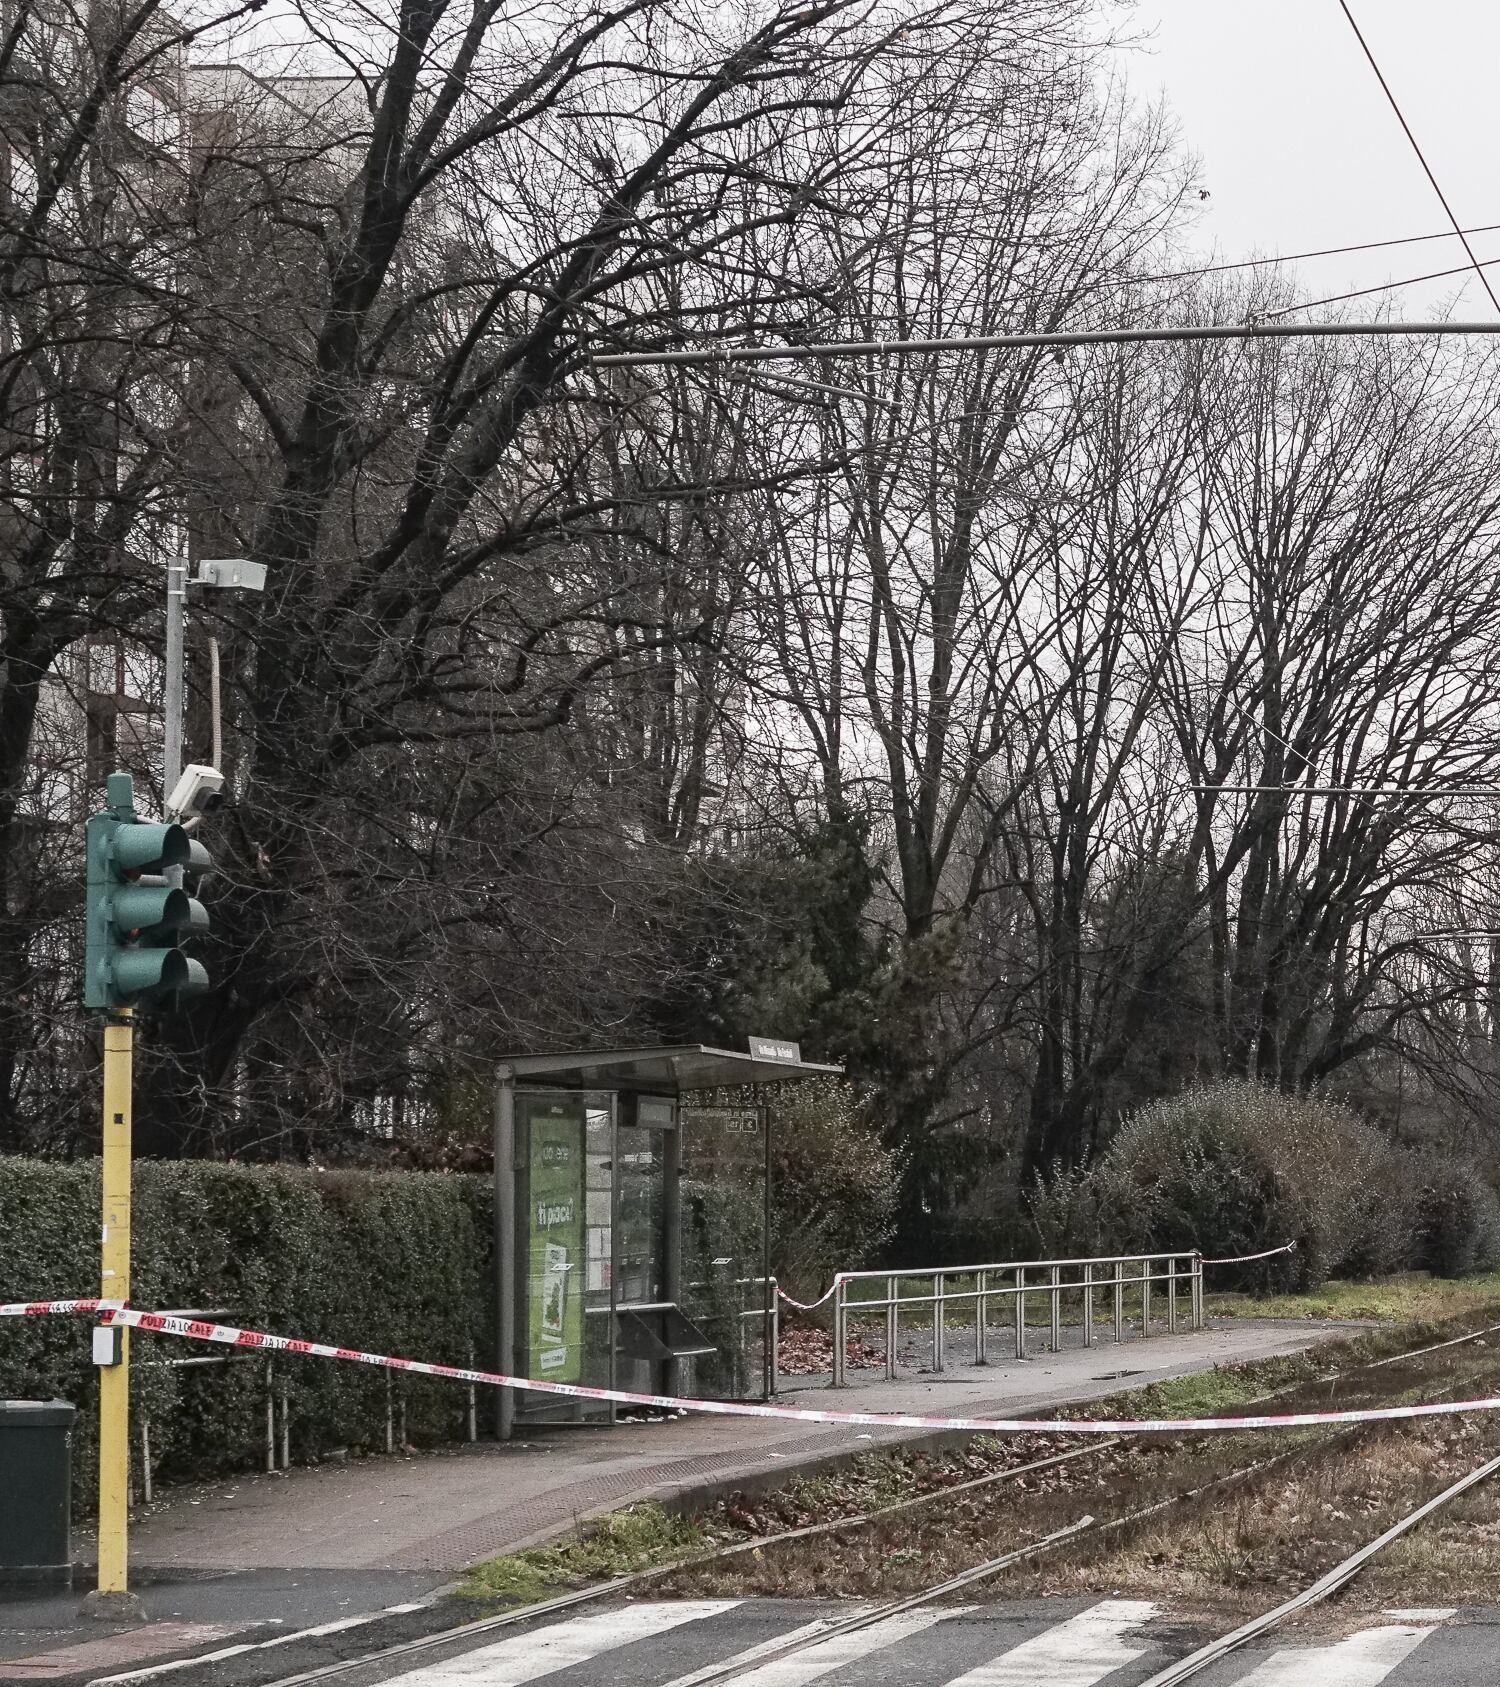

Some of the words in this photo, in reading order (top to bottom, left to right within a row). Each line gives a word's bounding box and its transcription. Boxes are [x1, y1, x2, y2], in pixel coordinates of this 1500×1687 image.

[140, 1314, 176, 1330] POLIZIA
[178, 1323, 212, 1338] LOCALE
[238, 1332, 273, 1347] POLIZIA
